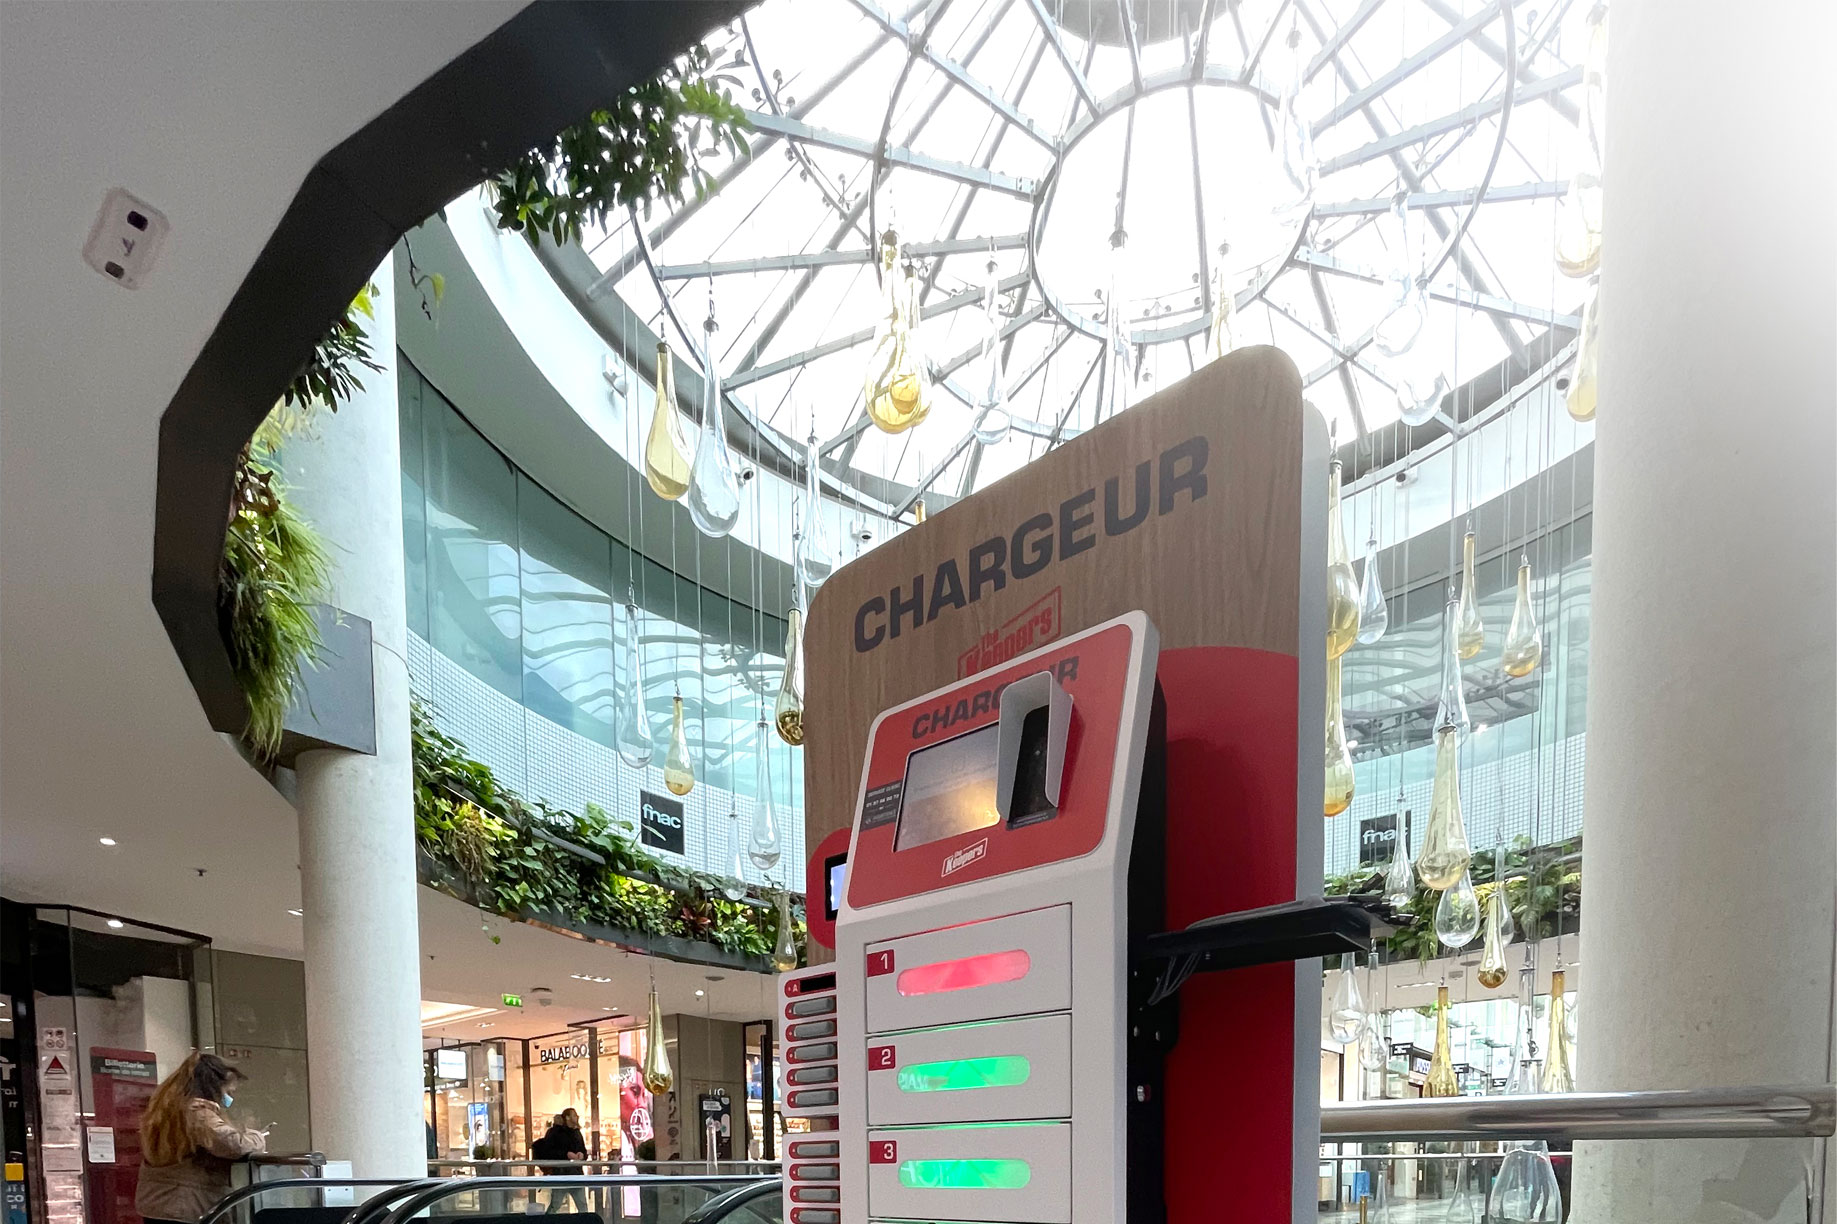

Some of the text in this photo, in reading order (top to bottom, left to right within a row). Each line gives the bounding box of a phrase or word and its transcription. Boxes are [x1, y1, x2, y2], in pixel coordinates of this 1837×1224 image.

[854, 435, 1209, 653] CHARGEUR
[912, 656, 1080, 740] CHARR
[642, 803, 682, 829] fnac
[1363, 827, 1408, 845] fna
[880, 952, 889, 970] 1
[881, 1048, 892, 1066] 2
[883, 1143, 894, 1160] 3
